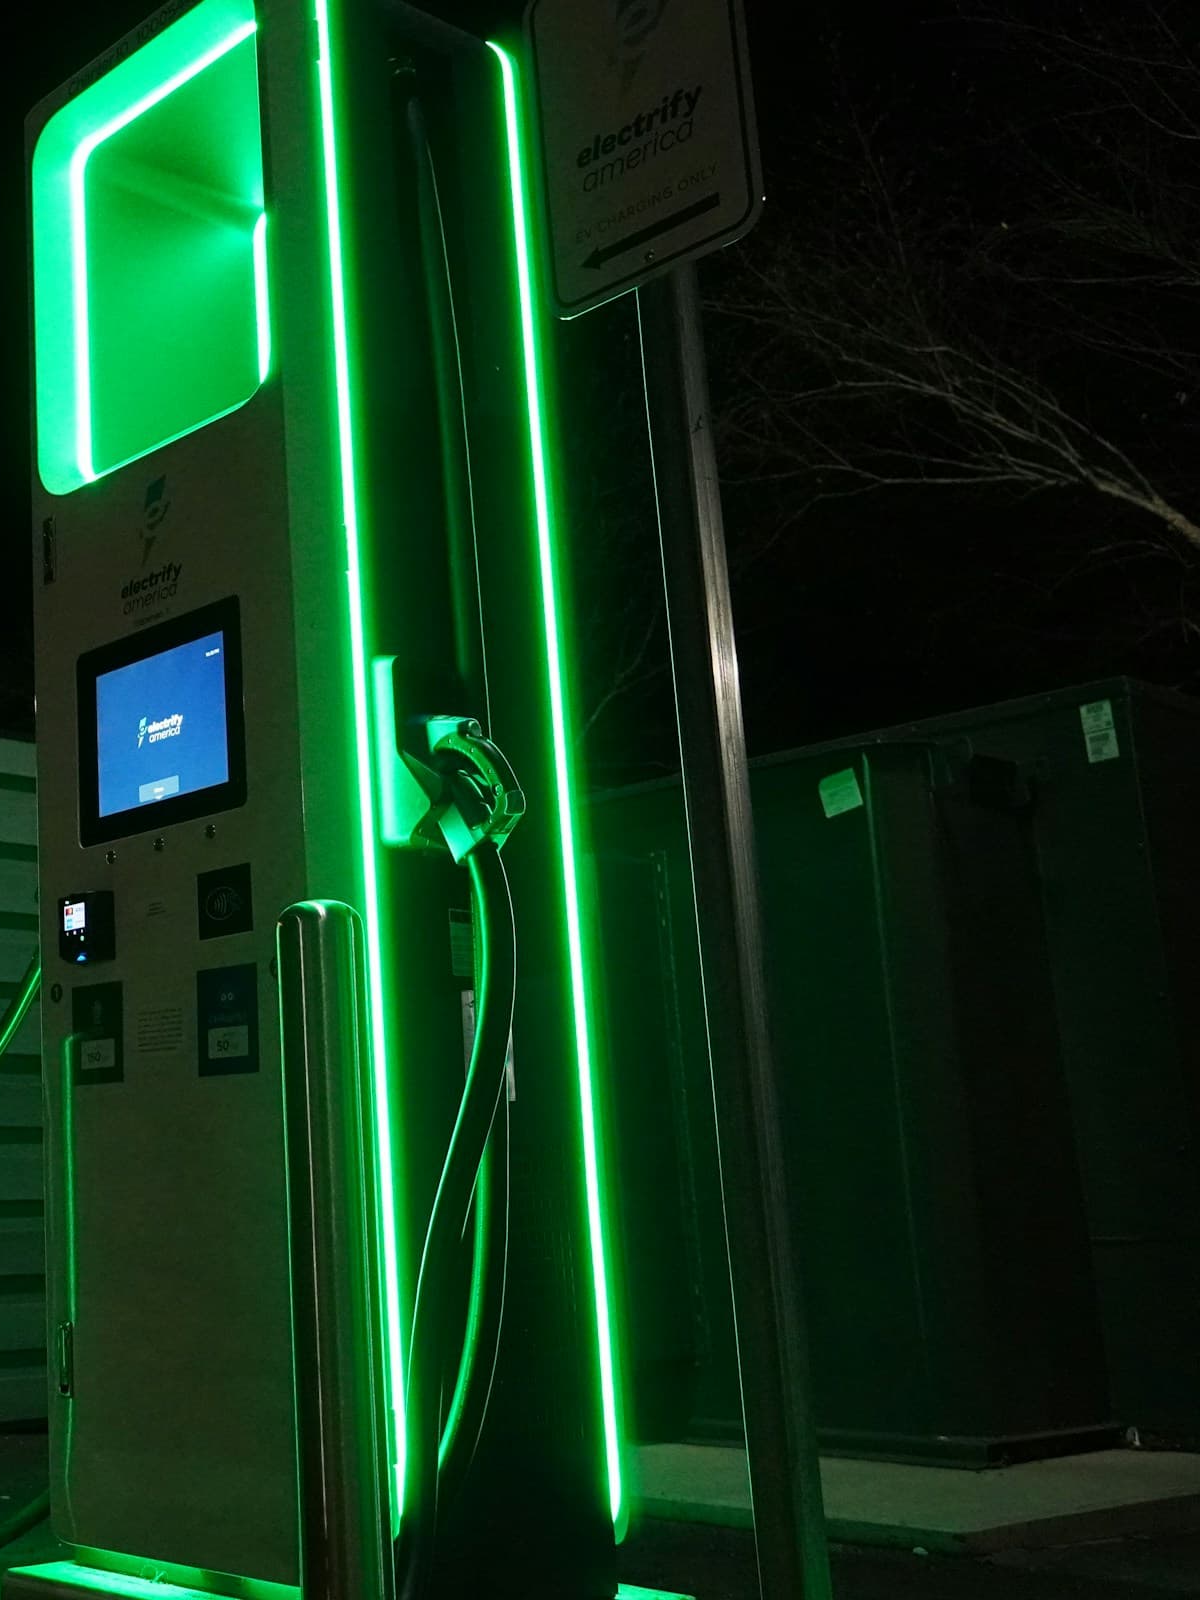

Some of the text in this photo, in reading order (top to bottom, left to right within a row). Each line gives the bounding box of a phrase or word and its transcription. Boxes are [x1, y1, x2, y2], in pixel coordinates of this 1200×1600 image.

[576, 85, 703, 169] electrify
[583, 118, 694, 192] america
[596, 186, 673, 234] CHARGING
[678, 159, 718, 192] ONLY
[121, 562, 182, 599] electrify
[123, 583, 177, 616] america
[147, 713, 184, 734] electrify
[148, 726, 181, 744] america
